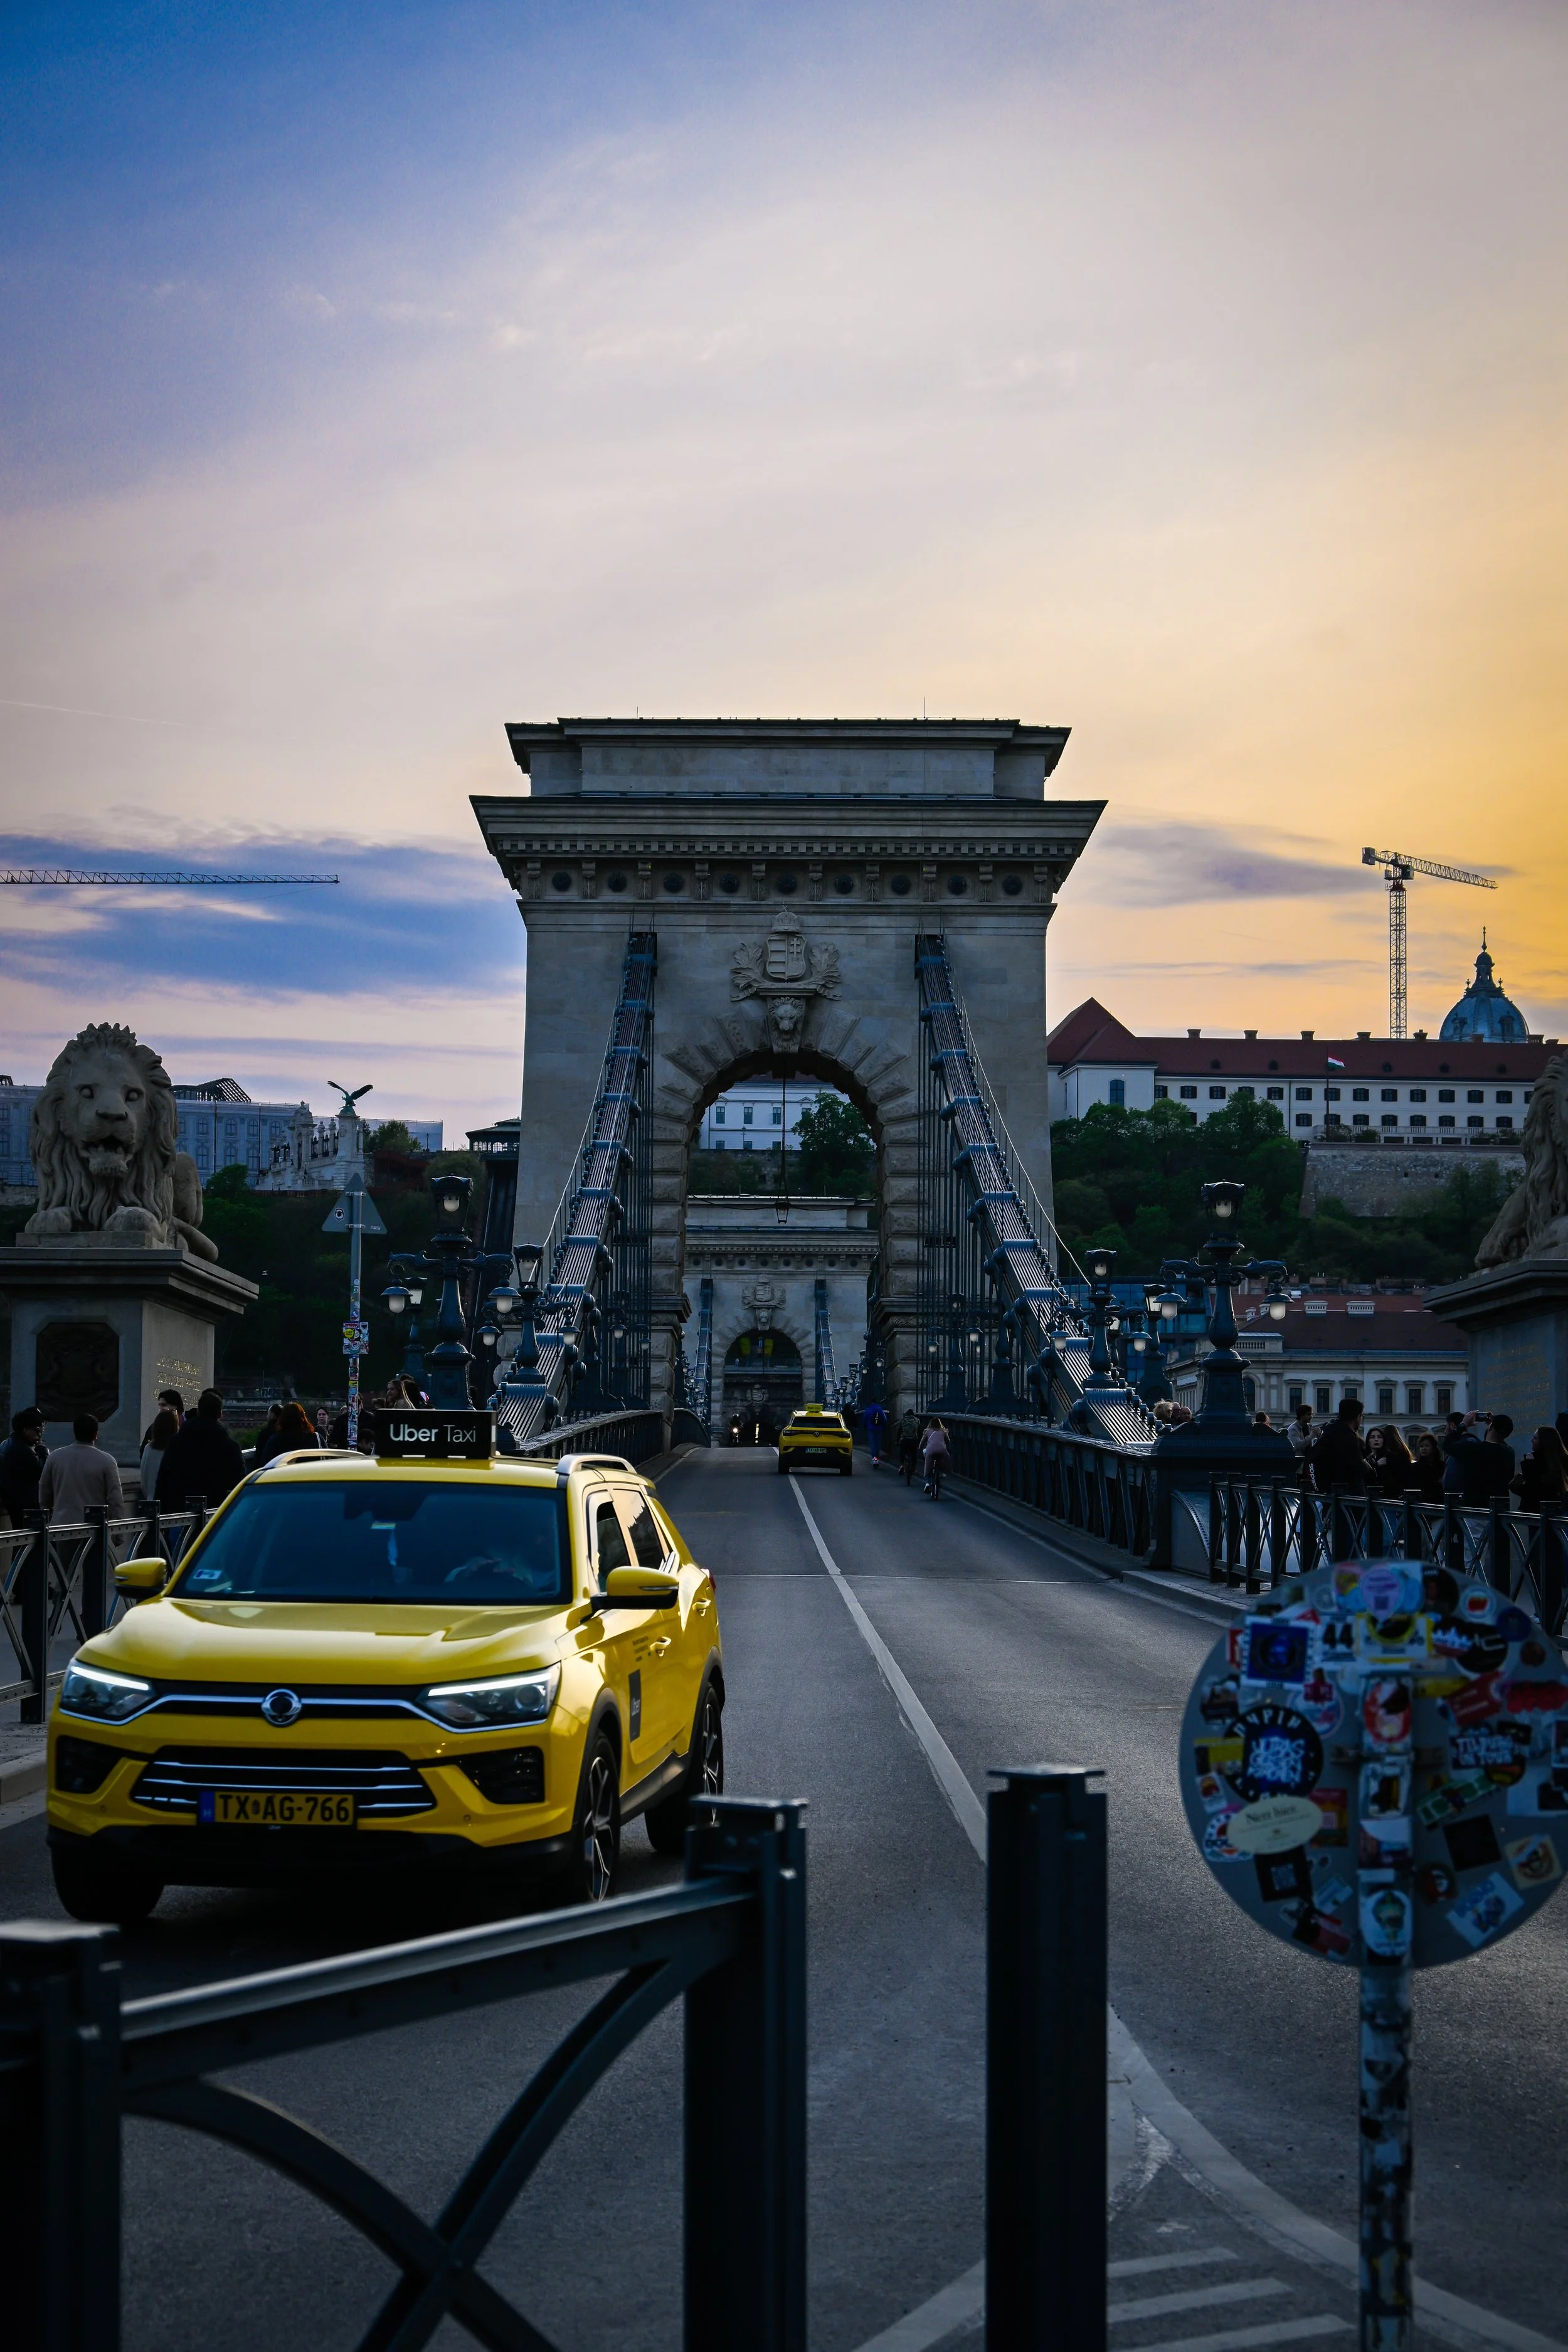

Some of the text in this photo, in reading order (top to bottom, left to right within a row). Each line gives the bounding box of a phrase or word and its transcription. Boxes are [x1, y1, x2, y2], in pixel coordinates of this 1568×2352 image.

[389, 1423, 476, 1443] Uber Taxi
[1308, 1463, 1319, 1491] adidas
[218, 1794, 349, 1822] TX AG-766
